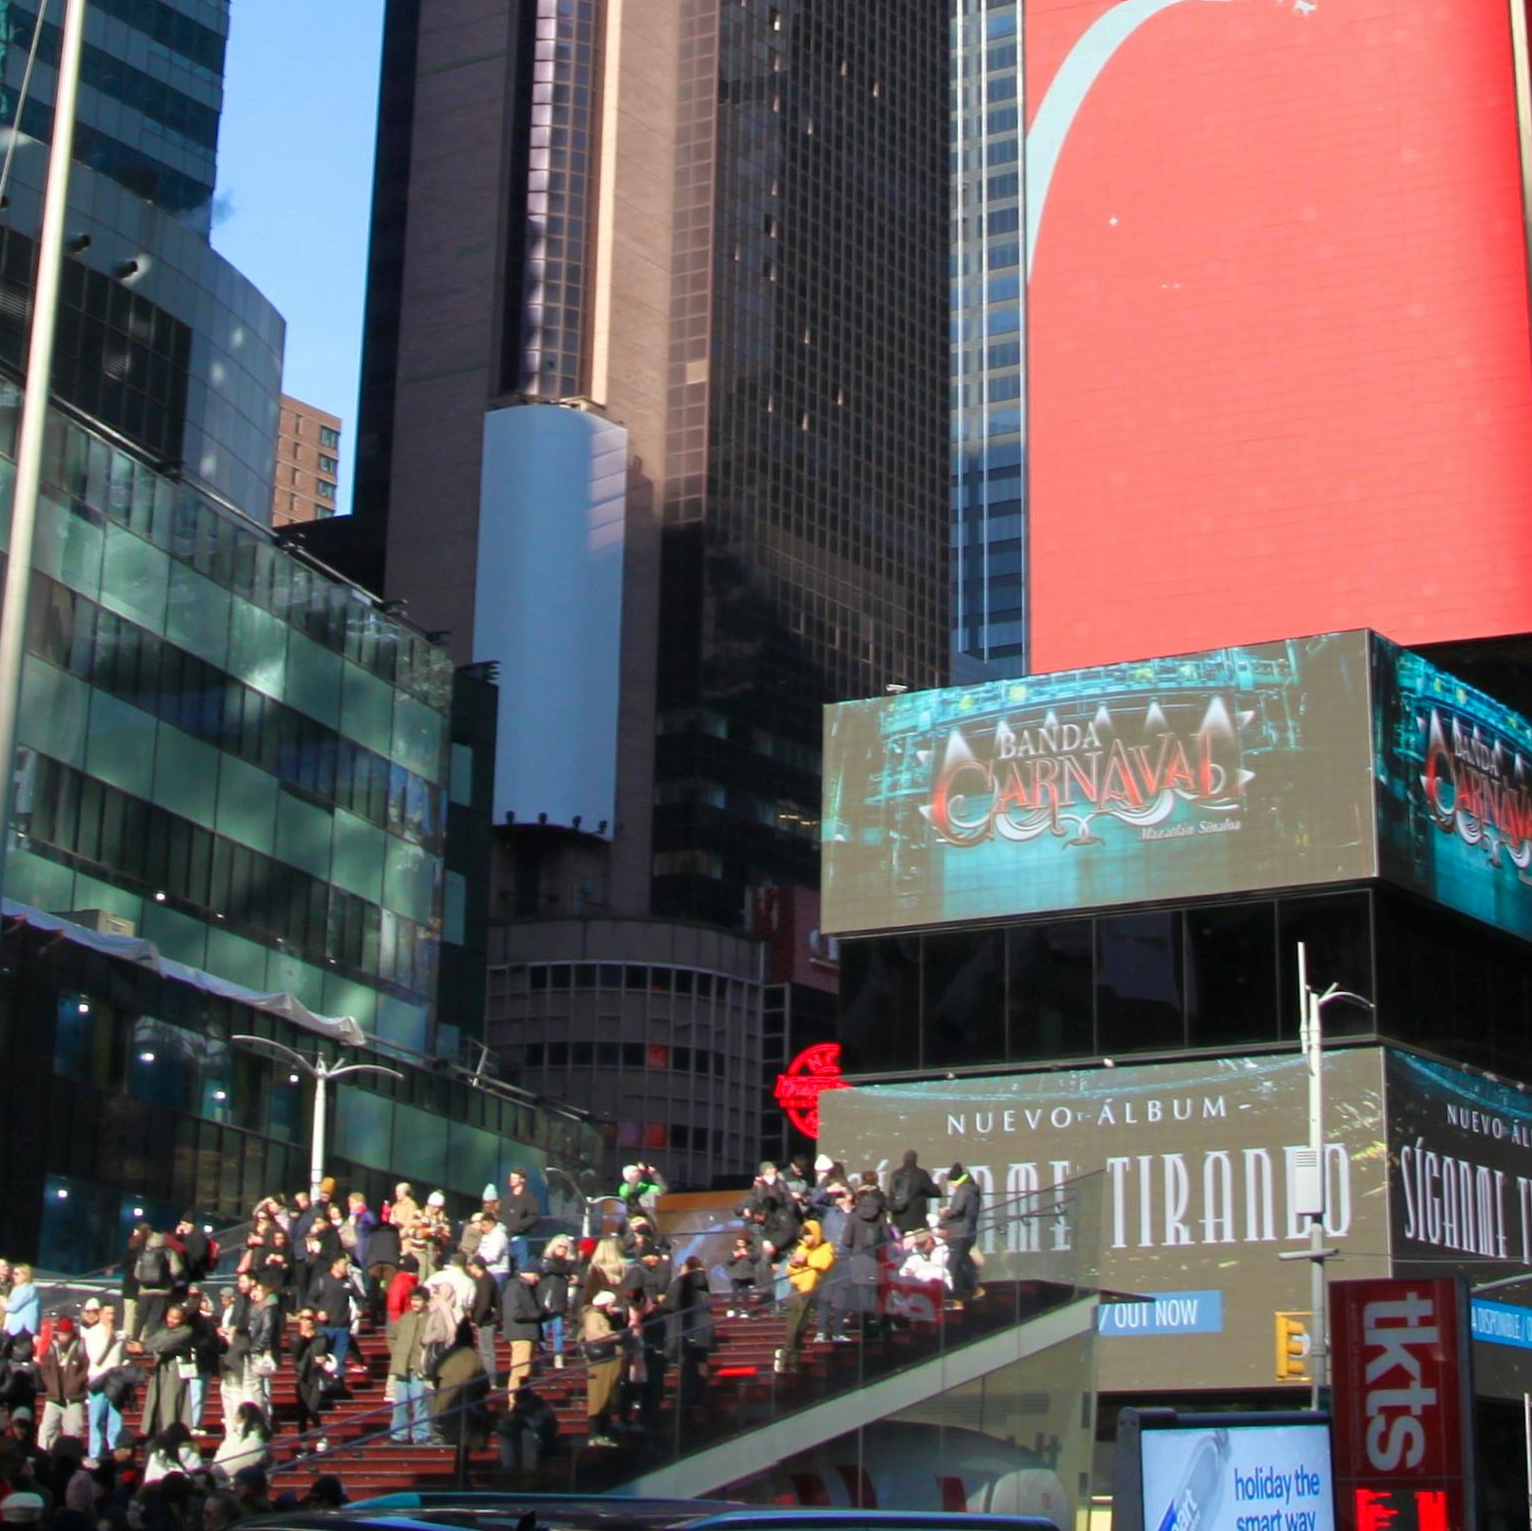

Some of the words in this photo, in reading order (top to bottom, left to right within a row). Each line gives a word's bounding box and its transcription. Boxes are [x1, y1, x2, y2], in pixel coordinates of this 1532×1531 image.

[998, 721, 1102, 761] BANDA
[931, 731, 1227, 849] CARNAVAL
[947, 1106, 1072, 1136] NUEVO
[1097, 1097, 1227, 1126] ÁLBUM
[1446, 1102, 1503, 1139] NUEVO
[1114, 1303, 1148, 1328] OUT
[1154, 1299, 1198, 1327] NOW
[1362, 1292, 1438, 1472] tkts
[1235, 1467, 1290, 1505] holiday
[1293, 1464, 1320, 1496] the
[1236, 1509, 1284, 1531] smart
